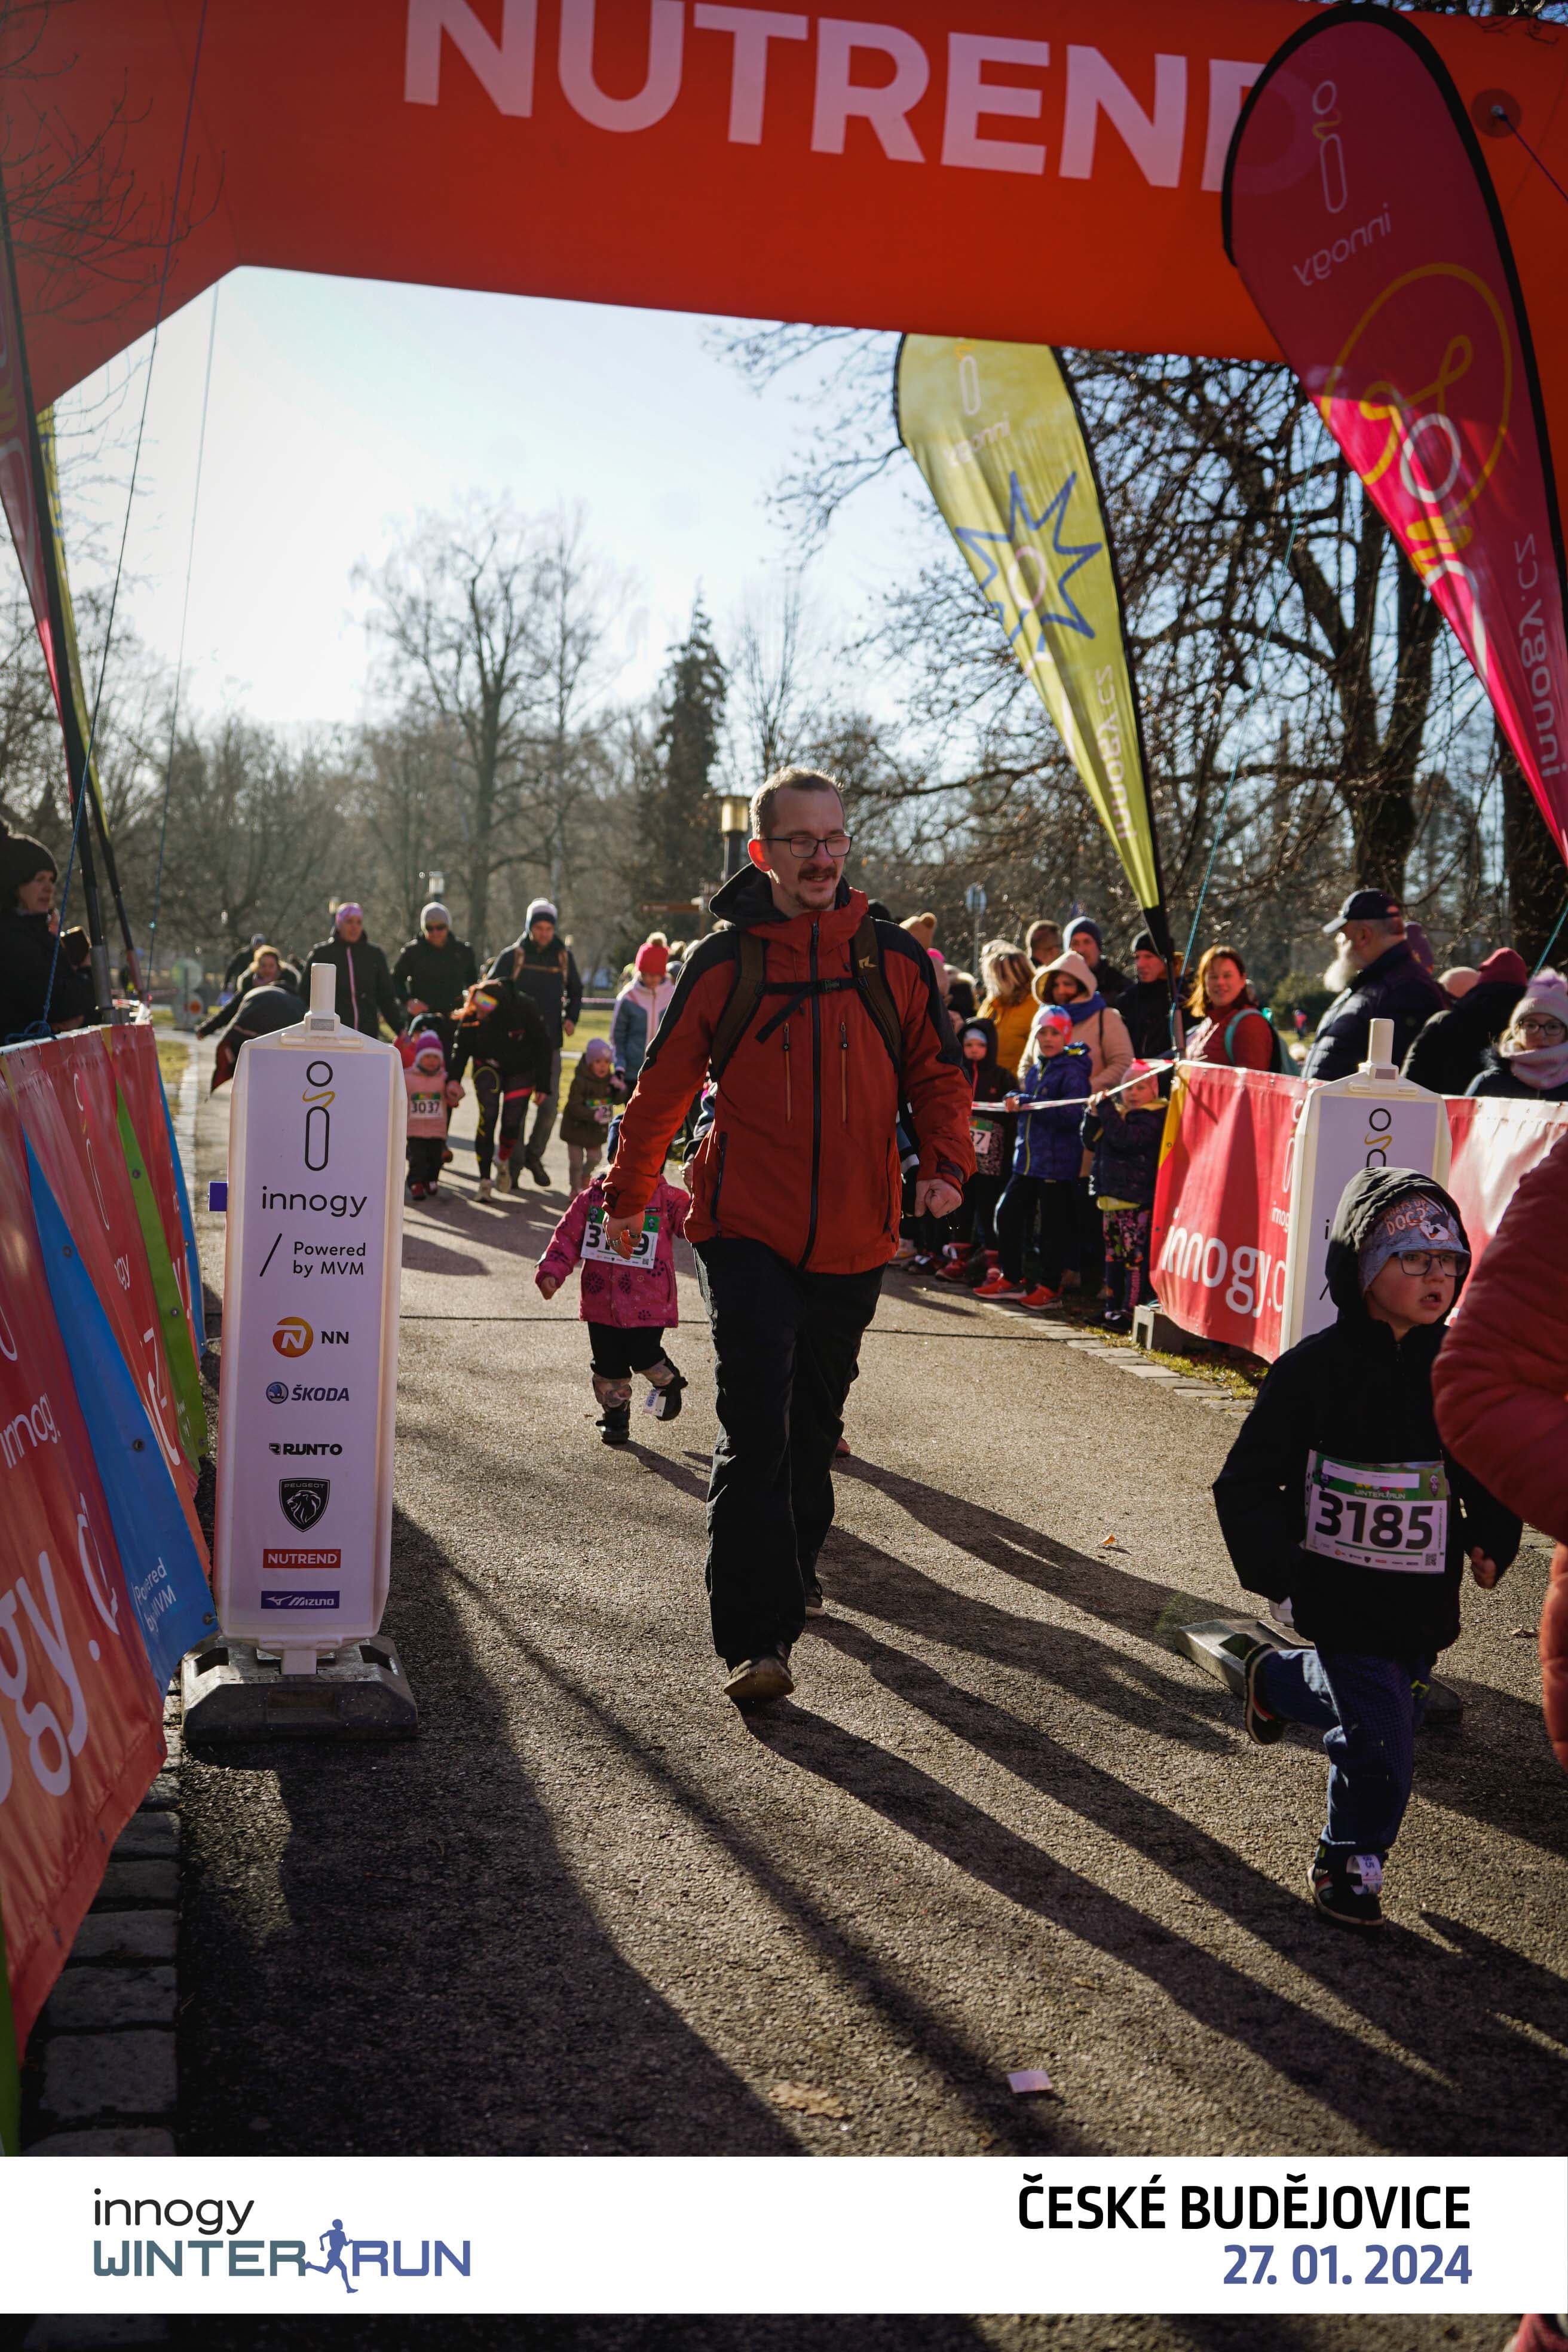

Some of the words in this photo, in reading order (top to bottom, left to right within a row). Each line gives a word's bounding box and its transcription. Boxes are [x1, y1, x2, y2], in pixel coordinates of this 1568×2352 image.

[262, 1186, 367, 1217] innogy
[294, 1241, 366, 1257] Powered
[293, 1261, 313, 1278] by
[320, 1261, 364, 1276] MVM
[321, 1330, 349, 1344] NN
[291, 1384, 350, 1402] ŠKODA
[283, 1443, 343, 1456] RUNTO
[1315, 1491, 1434, 1550] 3185
[267, 1554, 338, 1565] NUTREND
